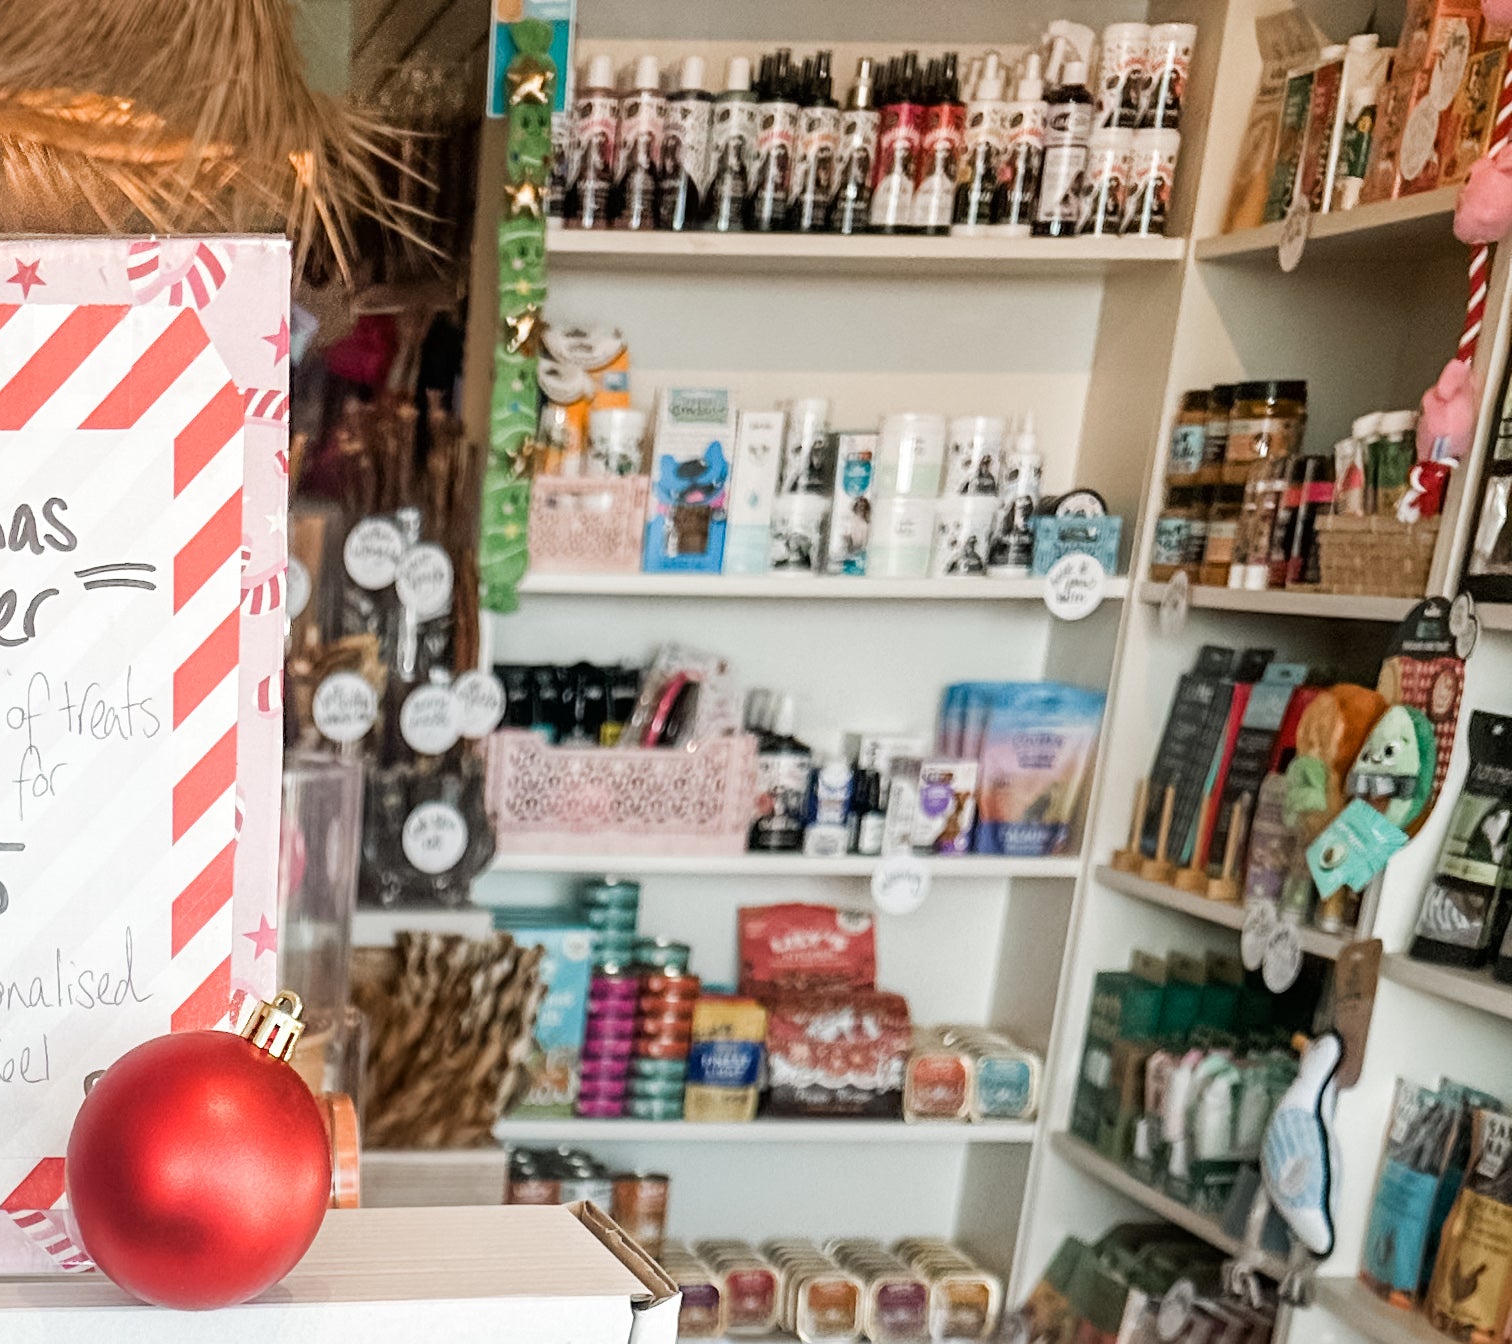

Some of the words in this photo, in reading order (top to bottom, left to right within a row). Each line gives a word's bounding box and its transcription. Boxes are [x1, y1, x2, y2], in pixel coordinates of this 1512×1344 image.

[6, 672, 50, 754] of
[59, 666, 160, 740] treats
[13, 745, 68, 821] for
